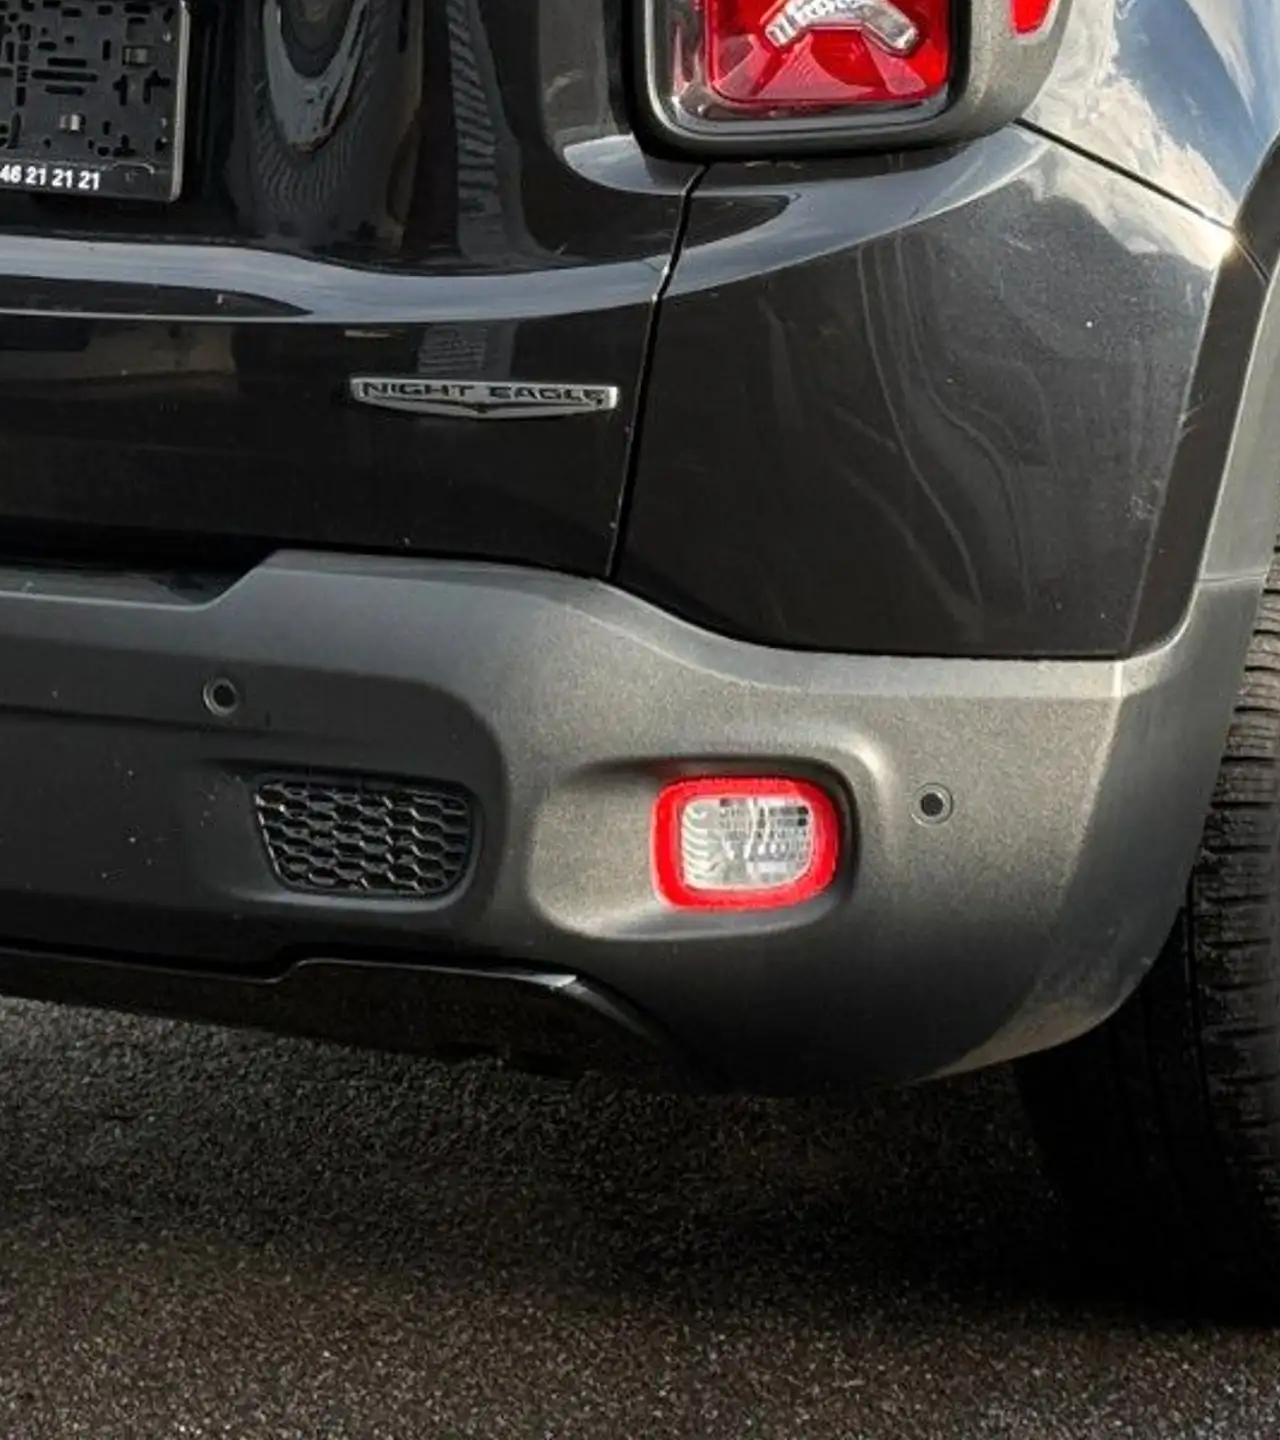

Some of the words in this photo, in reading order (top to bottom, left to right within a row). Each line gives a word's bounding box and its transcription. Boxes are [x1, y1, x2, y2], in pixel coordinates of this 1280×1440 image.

[24, 165, 48, 186] 21
[51, 168, 74, 189] 21
[77, 170, 101, 191] 21
[360, 381, 475, 400] NIGHT
[489, 384, 606, 402] EAGLE
